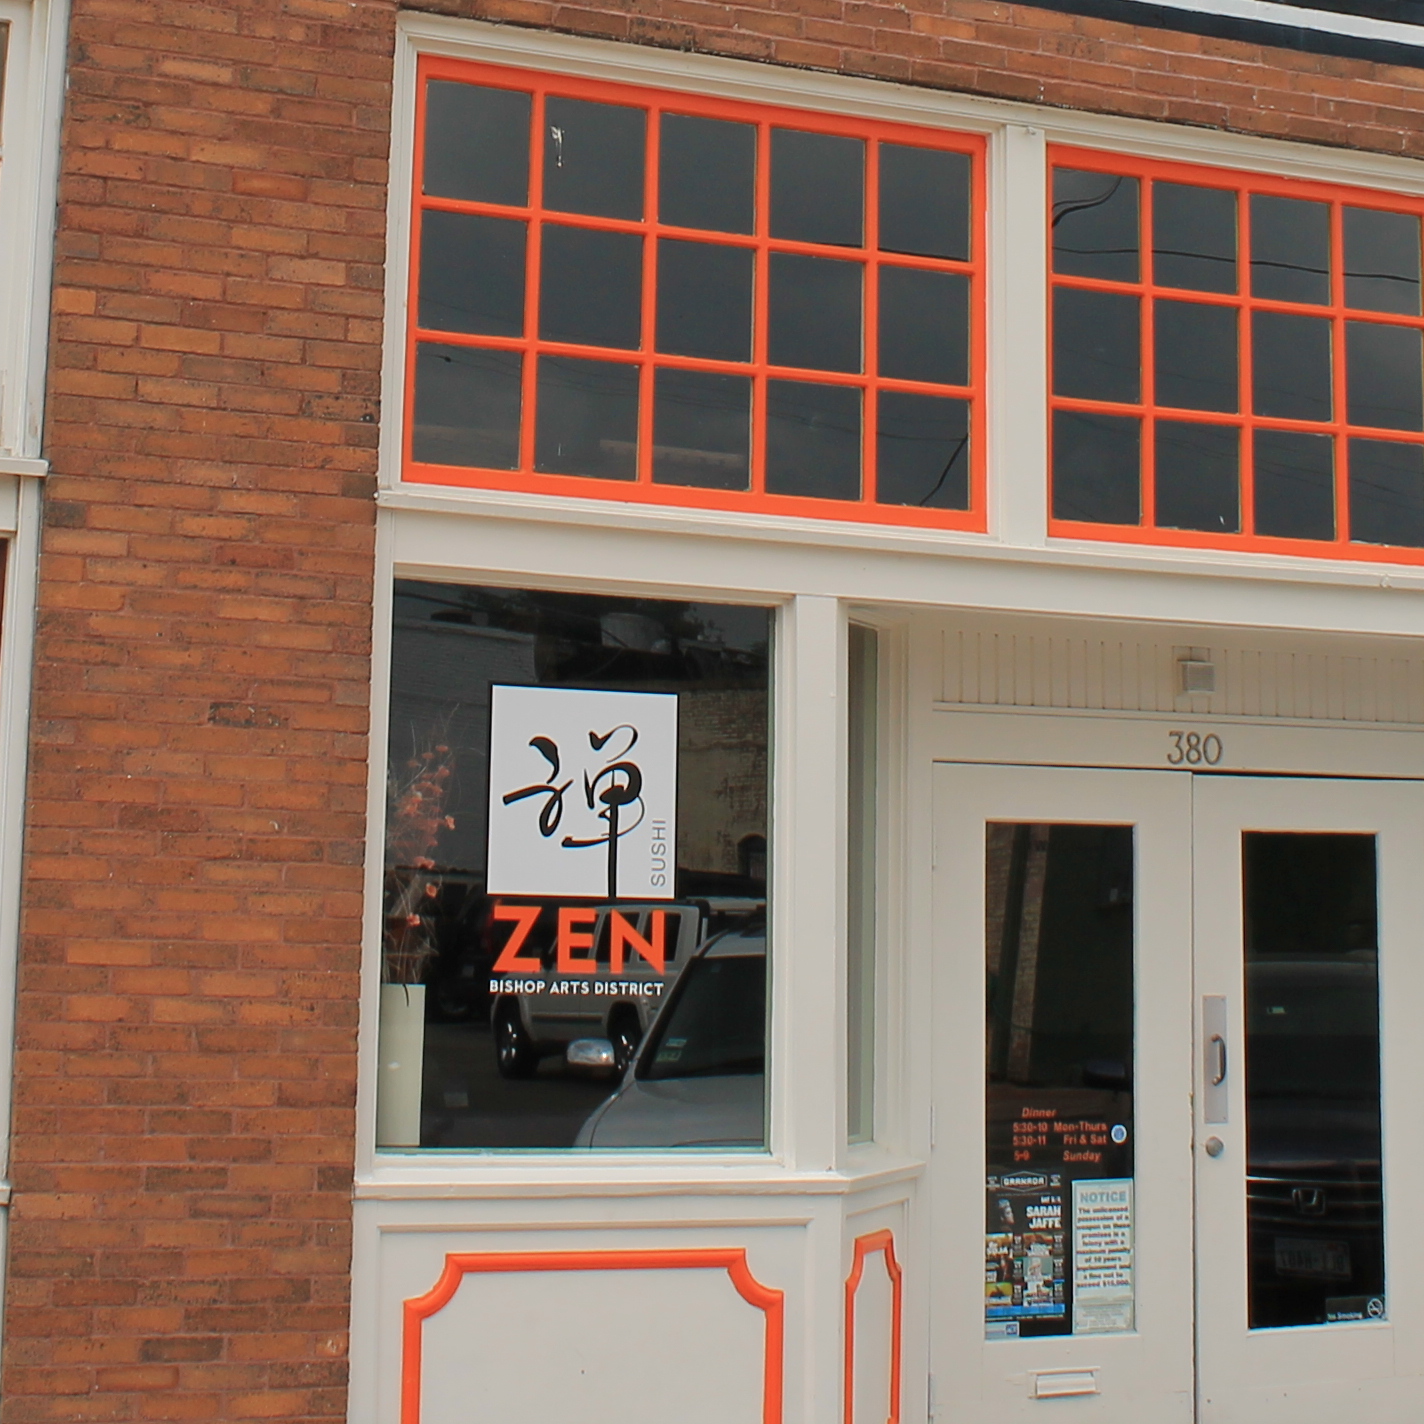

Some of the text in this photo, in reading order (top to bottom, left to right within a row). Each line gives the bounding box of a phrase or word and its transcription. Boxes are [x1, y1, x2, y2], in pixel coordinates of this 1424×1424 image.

[1167, 730, 1222, 765] 380
[650, 819, 667, 887] SUSHI
[492, 905, 665, 975] ZEN
[489, 980, 664, 996] BISHOP ARTS DISTRICT
[1022, 1108, 1056, 1118] Dinner
[1013, 1121, 1107, 1133] 5:30-10 Mon-Thurs
[1013, 1134, 1107, 1145] 5:30-11 Fri & Sat
[1014, 1150, 1101, 1163] 5-9 Sunday
[1080, 1191, 1126, 1202] NOTICE
[1026, 1205, 1061, 1218] SARAH
[1029, 1217, 1061, 1229] JAFFE
